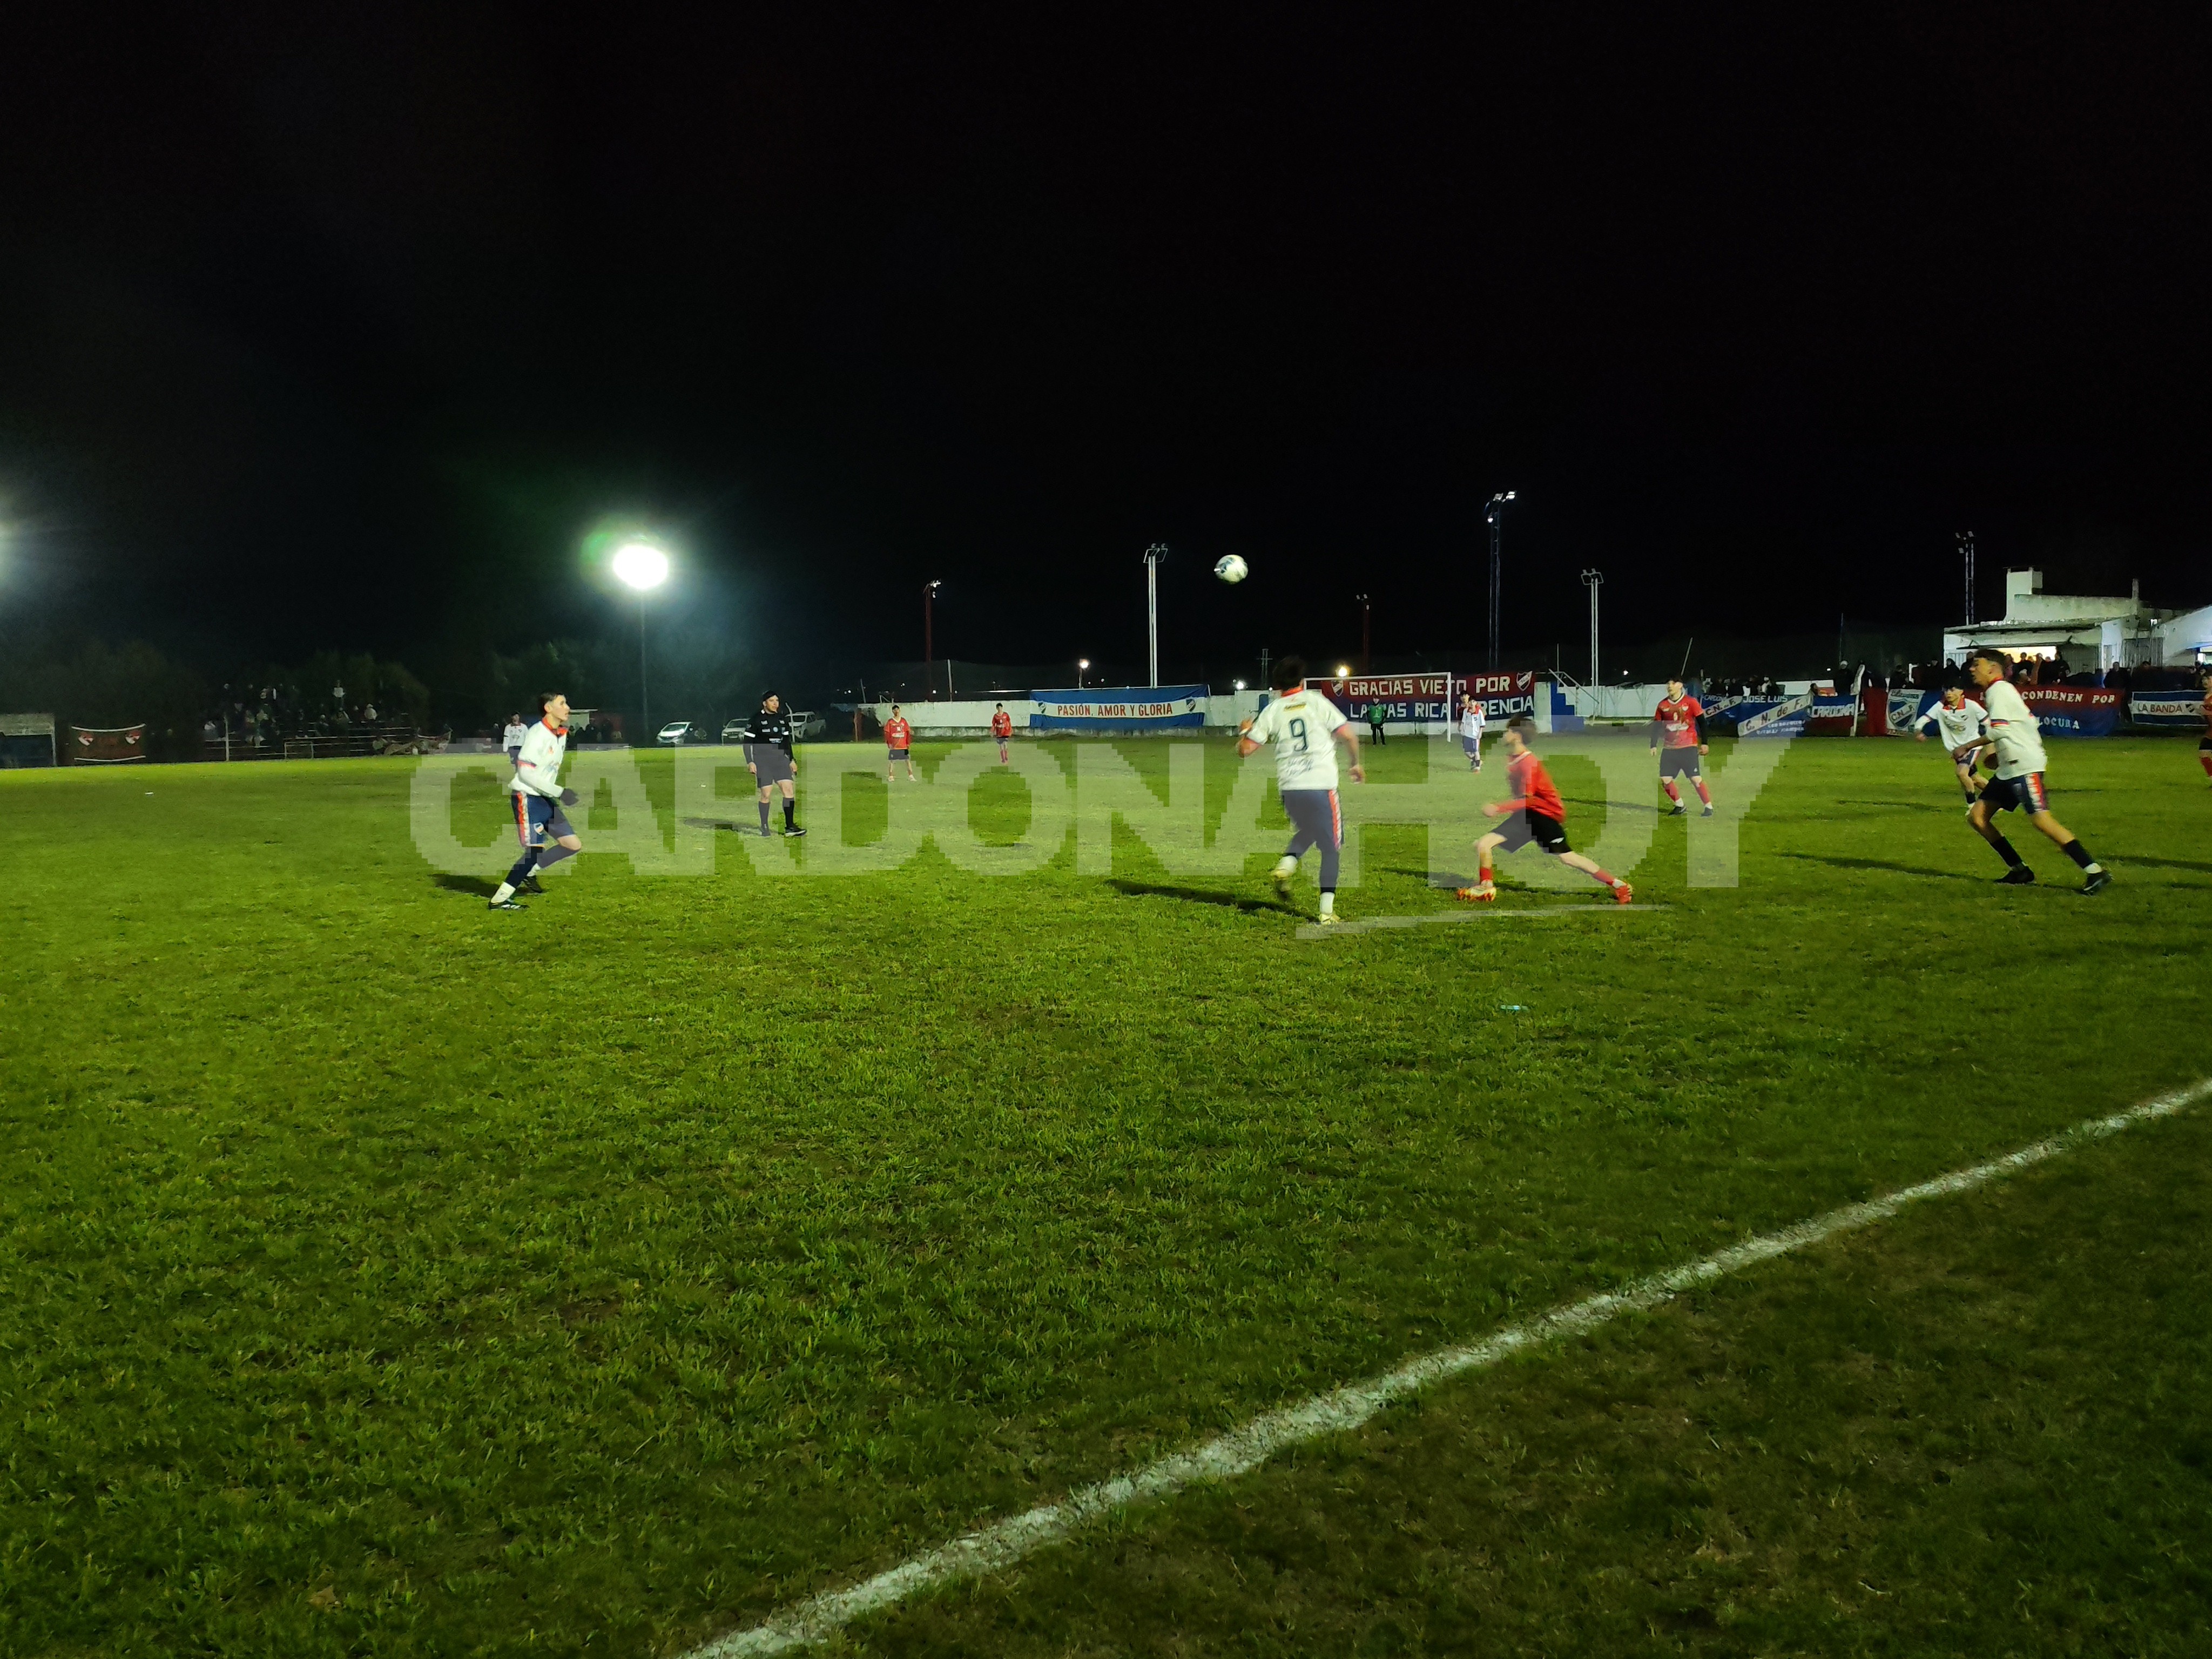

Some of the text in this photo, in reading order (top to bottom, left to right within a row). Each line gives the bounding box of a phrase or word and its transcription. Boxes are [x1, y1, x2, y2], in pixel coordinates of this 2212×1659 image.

[1349, 679, 1413, 696] GRACIAS
[1475, 676, 1510, 693] POR
[2021, 690, 2115, 704] CONDENEN POR
[1098, 705, 1127, 716] AMOR
[1130, 705, 1135, 716] Y
[1138, 703, 1173, 716] GLORIA
[1383, 703, 1406, 718] AS
[1415, 702, 1448, 718] RICA
[1455, 696, 1534, 718] RENCIA
[1761, 712, 1771, 725] N.
[1777, 706, 1787, 717] de
[1794, 699, 1803, 709] F.
[1812, 703, 1855, 718] CARDONA
[2137, 703, 2183, 713] LA BANDA
[2036, 717, 2080, 729] LOCURA
[1290, 717, 1309, 752] 9
